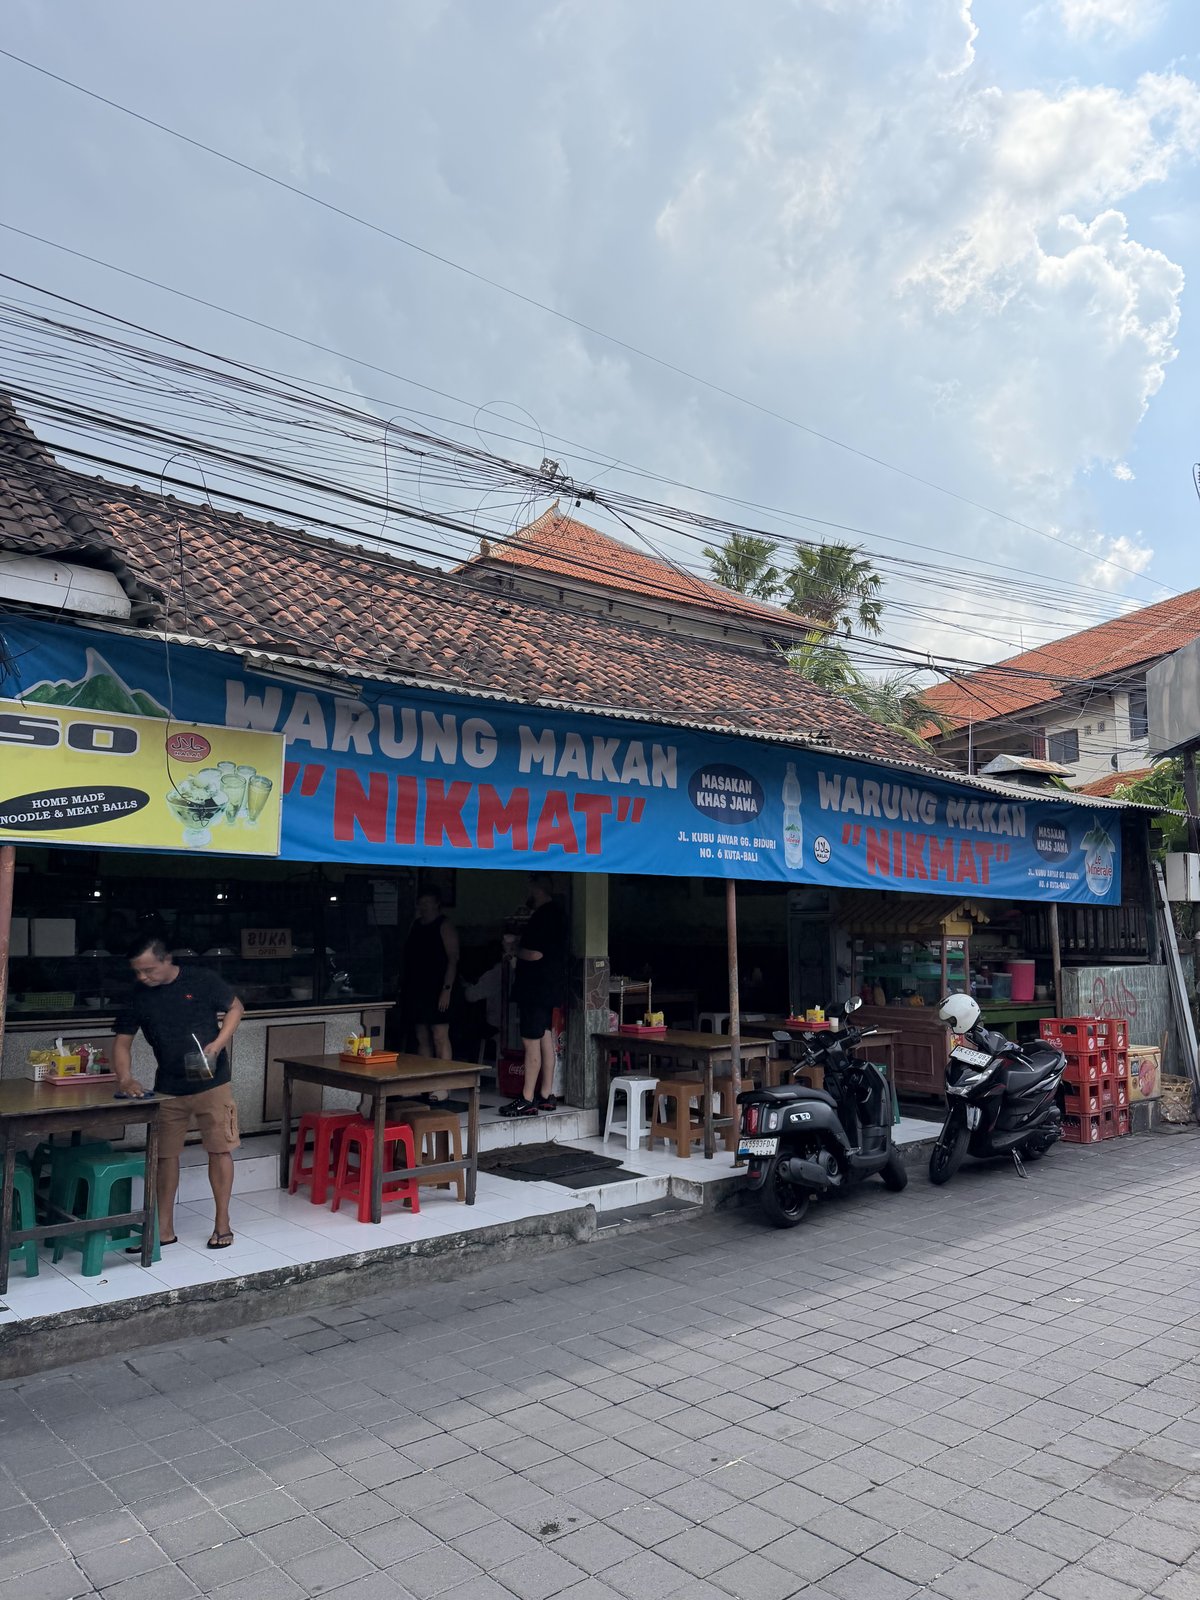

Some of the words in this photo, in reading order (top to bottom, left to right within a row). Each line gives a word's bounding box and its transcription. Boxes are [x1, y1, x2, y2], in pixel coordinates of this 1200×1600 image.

[225, 679, 498, 770] WARUNG
[518, 724, 678, 789] MAKAN
[174, 751, 202, 759] HALAL
[701, 773, 752, 795] MASAKAN
[32, 797, 69, 809] HOME
[71, 792, 106, 804] MADE
[696, 791, 727, 809] KHAS
[729, 796, 758, 813] JAWA
[817, 771, 938, 825] WARUNG
[946, 797, 1026, 838] MAKAN
[0, 810, 51, 825] NOODLE
[54, 809, 64, 818] &
[66, 805, 99, 817] MEAT
[102, 800, 138, 812] BALLS
[677, 831, 689, 842] JL.
[691, 832, 714, 843] KUBU
[717, 833, 739, 846] ANYAR
[740, 836, 752, 847] GG.
[753, 838, 777, 850] BIDURI
[1038, 826, 1066, 840] MASAKAN
[1036, 839, 1052, 851] KHAS
[699, 847, 715, 858] NO.
[717, 848, 723, 859] 6
[724, 849, 759, 863] KUTA-BALI
[1086, 862, 1113, 878] Minerale
[247, 931, 287, 947] BUKA
